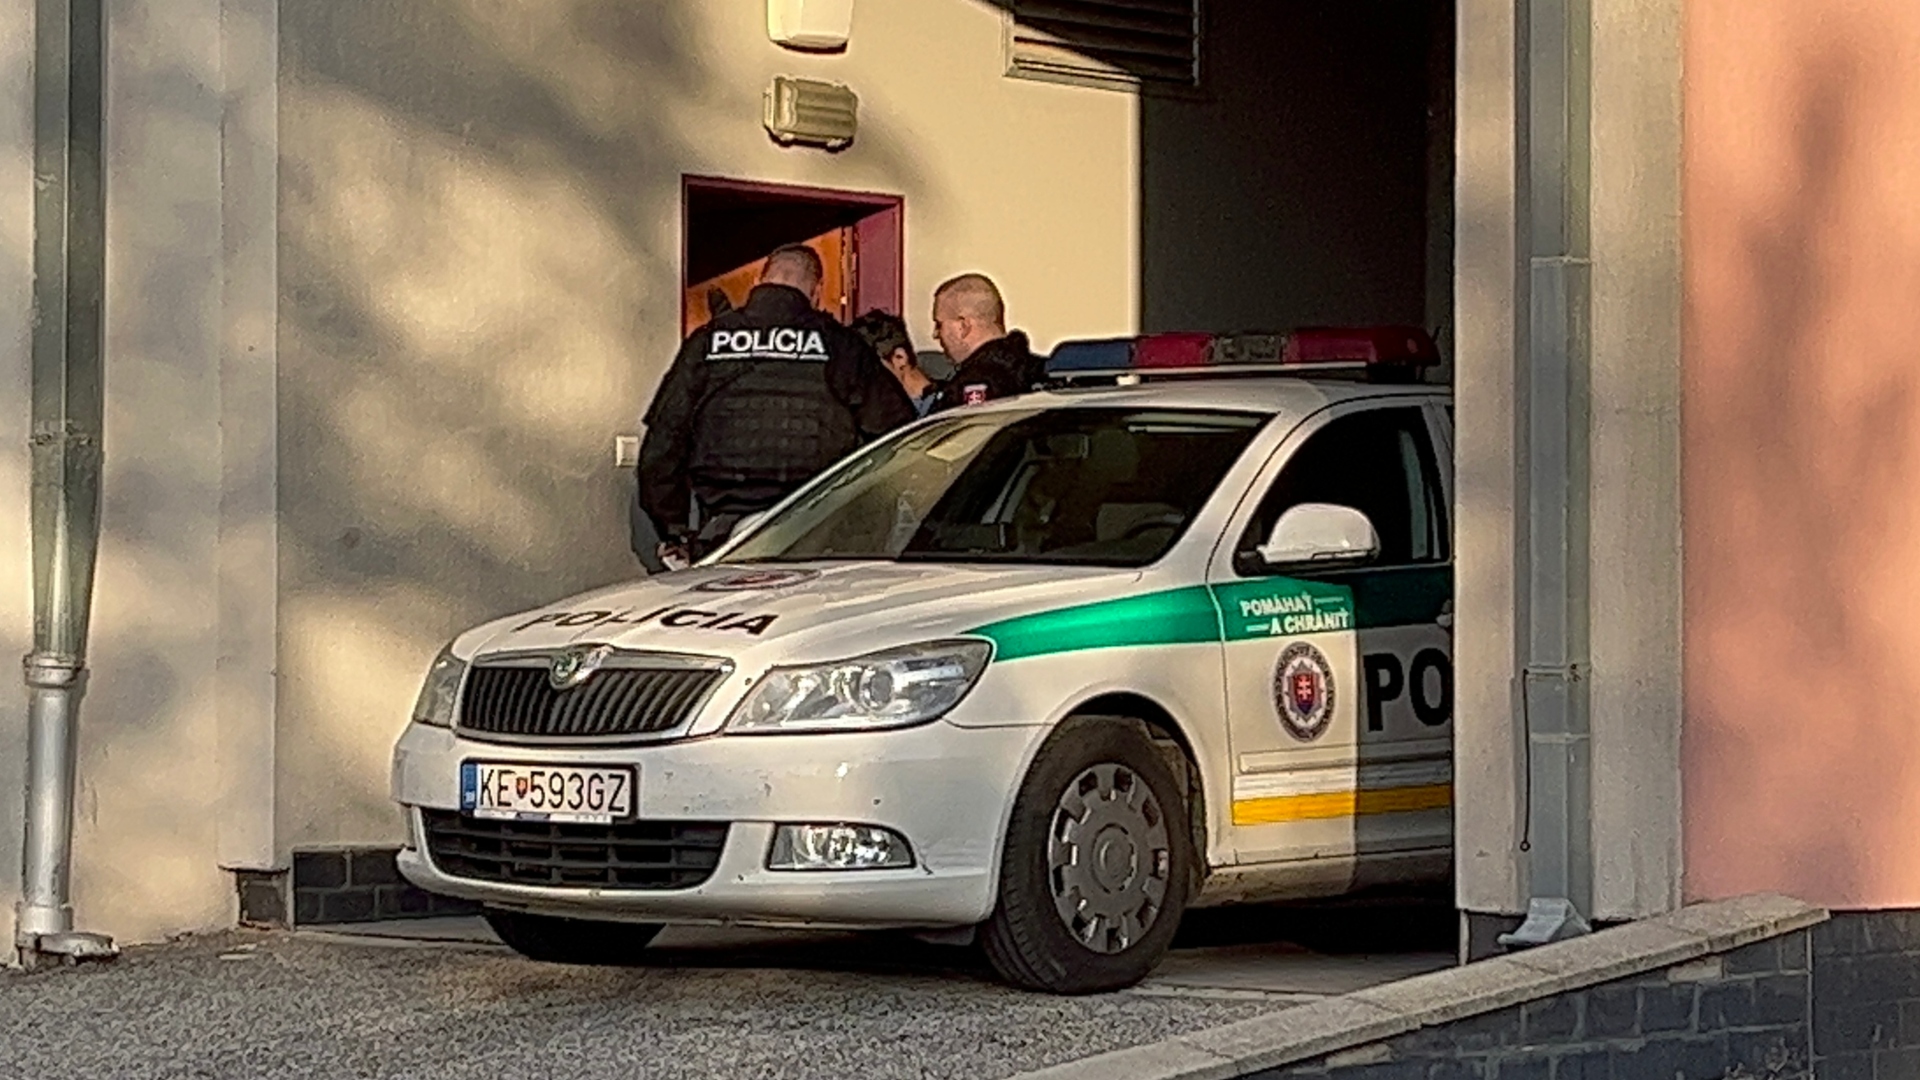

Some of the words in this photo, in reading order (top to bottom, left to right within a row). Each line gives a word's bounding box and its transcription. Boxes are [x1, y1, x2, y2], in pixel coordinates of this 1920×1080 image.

[711, 327, 825, 353] POLÍCIA
[1240, 590, 1312, 617] POMÁHAŤ
[510, 602, 779, 636] POLÍCIA
[1270, 617, 1282, 635] A
[1284, 607, 1349, 633] CHRÁNIŤ
